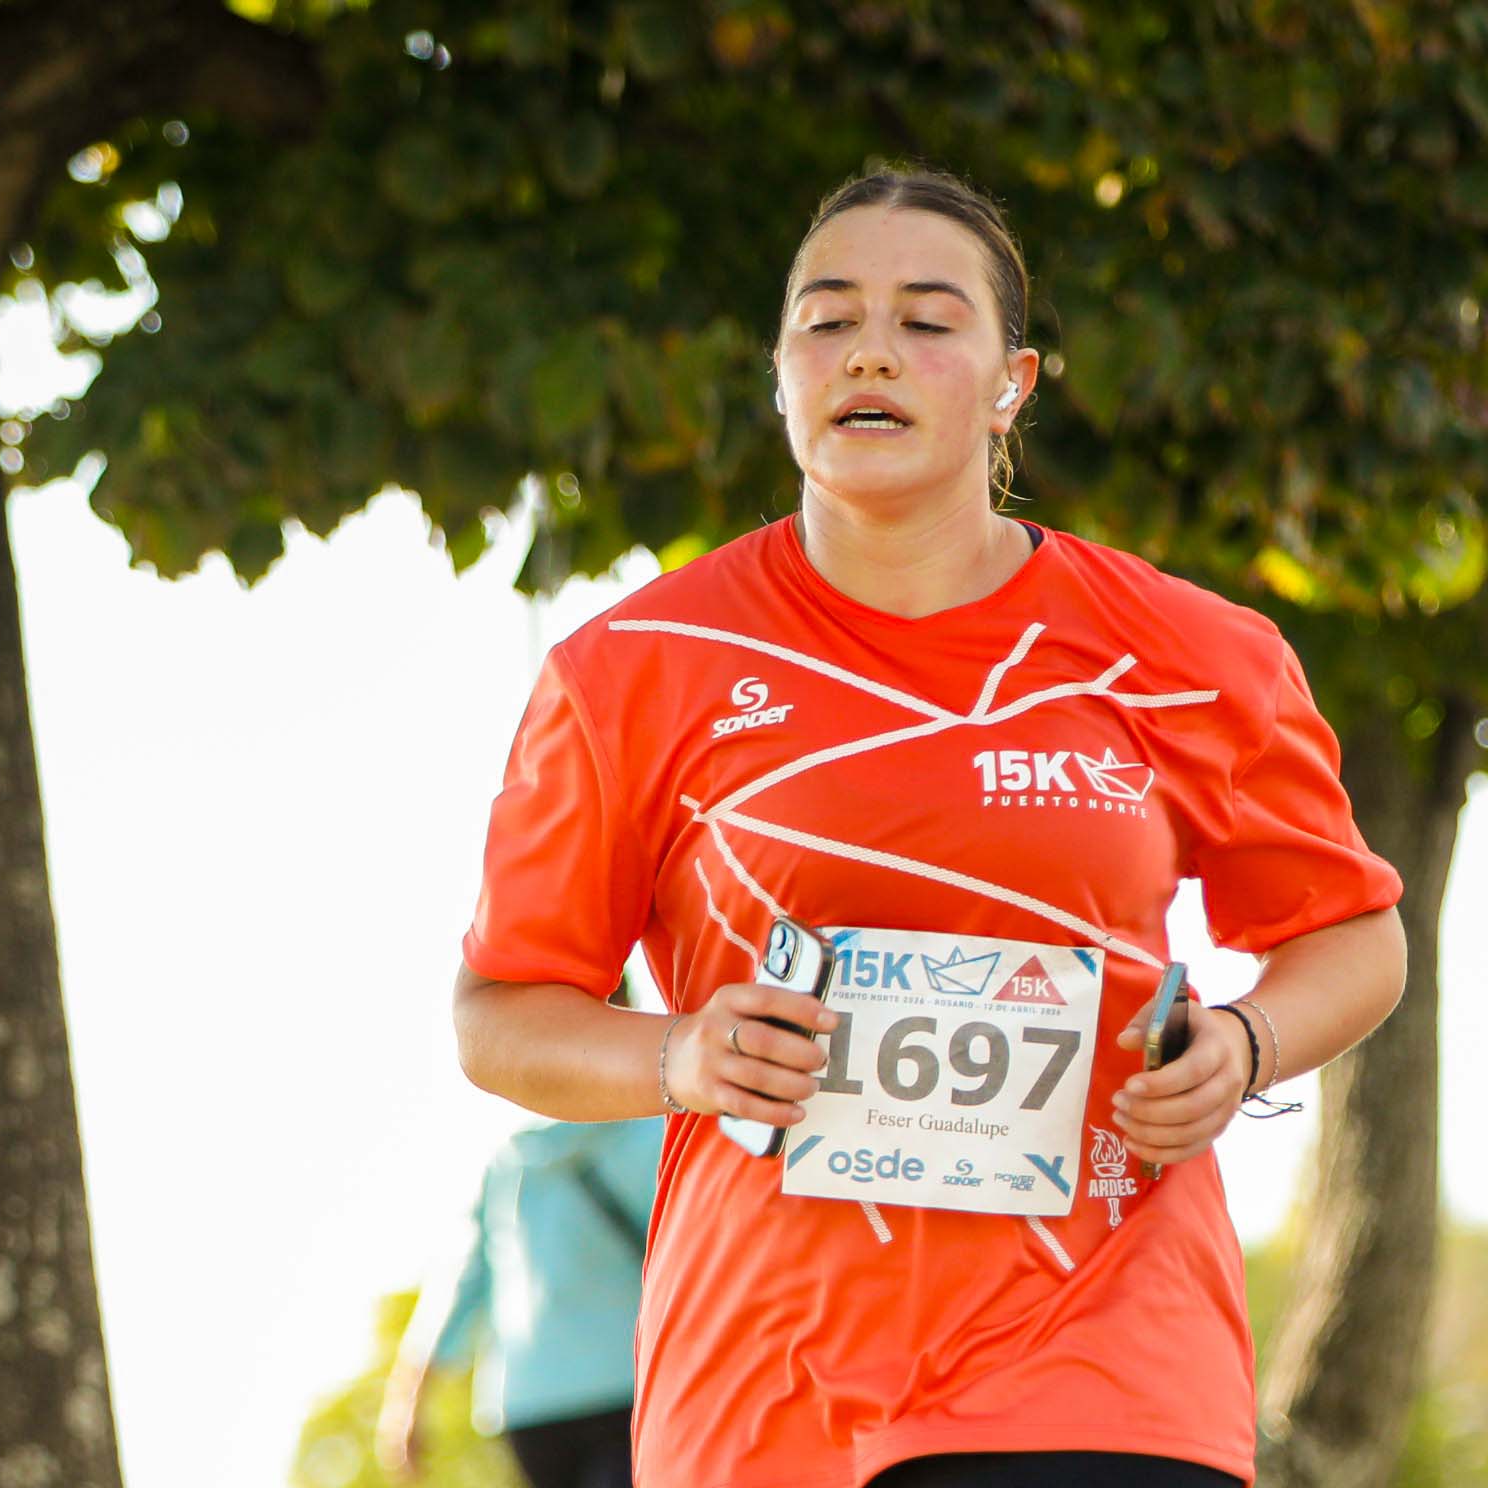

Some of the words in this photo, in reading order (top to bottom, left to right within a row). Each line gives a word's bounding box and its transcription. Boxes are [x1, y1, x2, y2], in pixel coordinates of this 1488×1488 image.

[973, 750, 1077, 792] 15K
[983, 795, 1079, 808] PUERTO
[1088, 798, 1148, 819] NORTE
[836, 949, 915, 990] 15K
[1011, 976, 1051, 998] 15K
[814, 1011, 1082, 1111] 1697
[866, 1109, 914, 1129] Feser
[918, 1113, 1010, 1140] Guadalupe
[828, 1148, 926, 1182] osde
[1087, 1178, 1138, 1197] ARDEC
